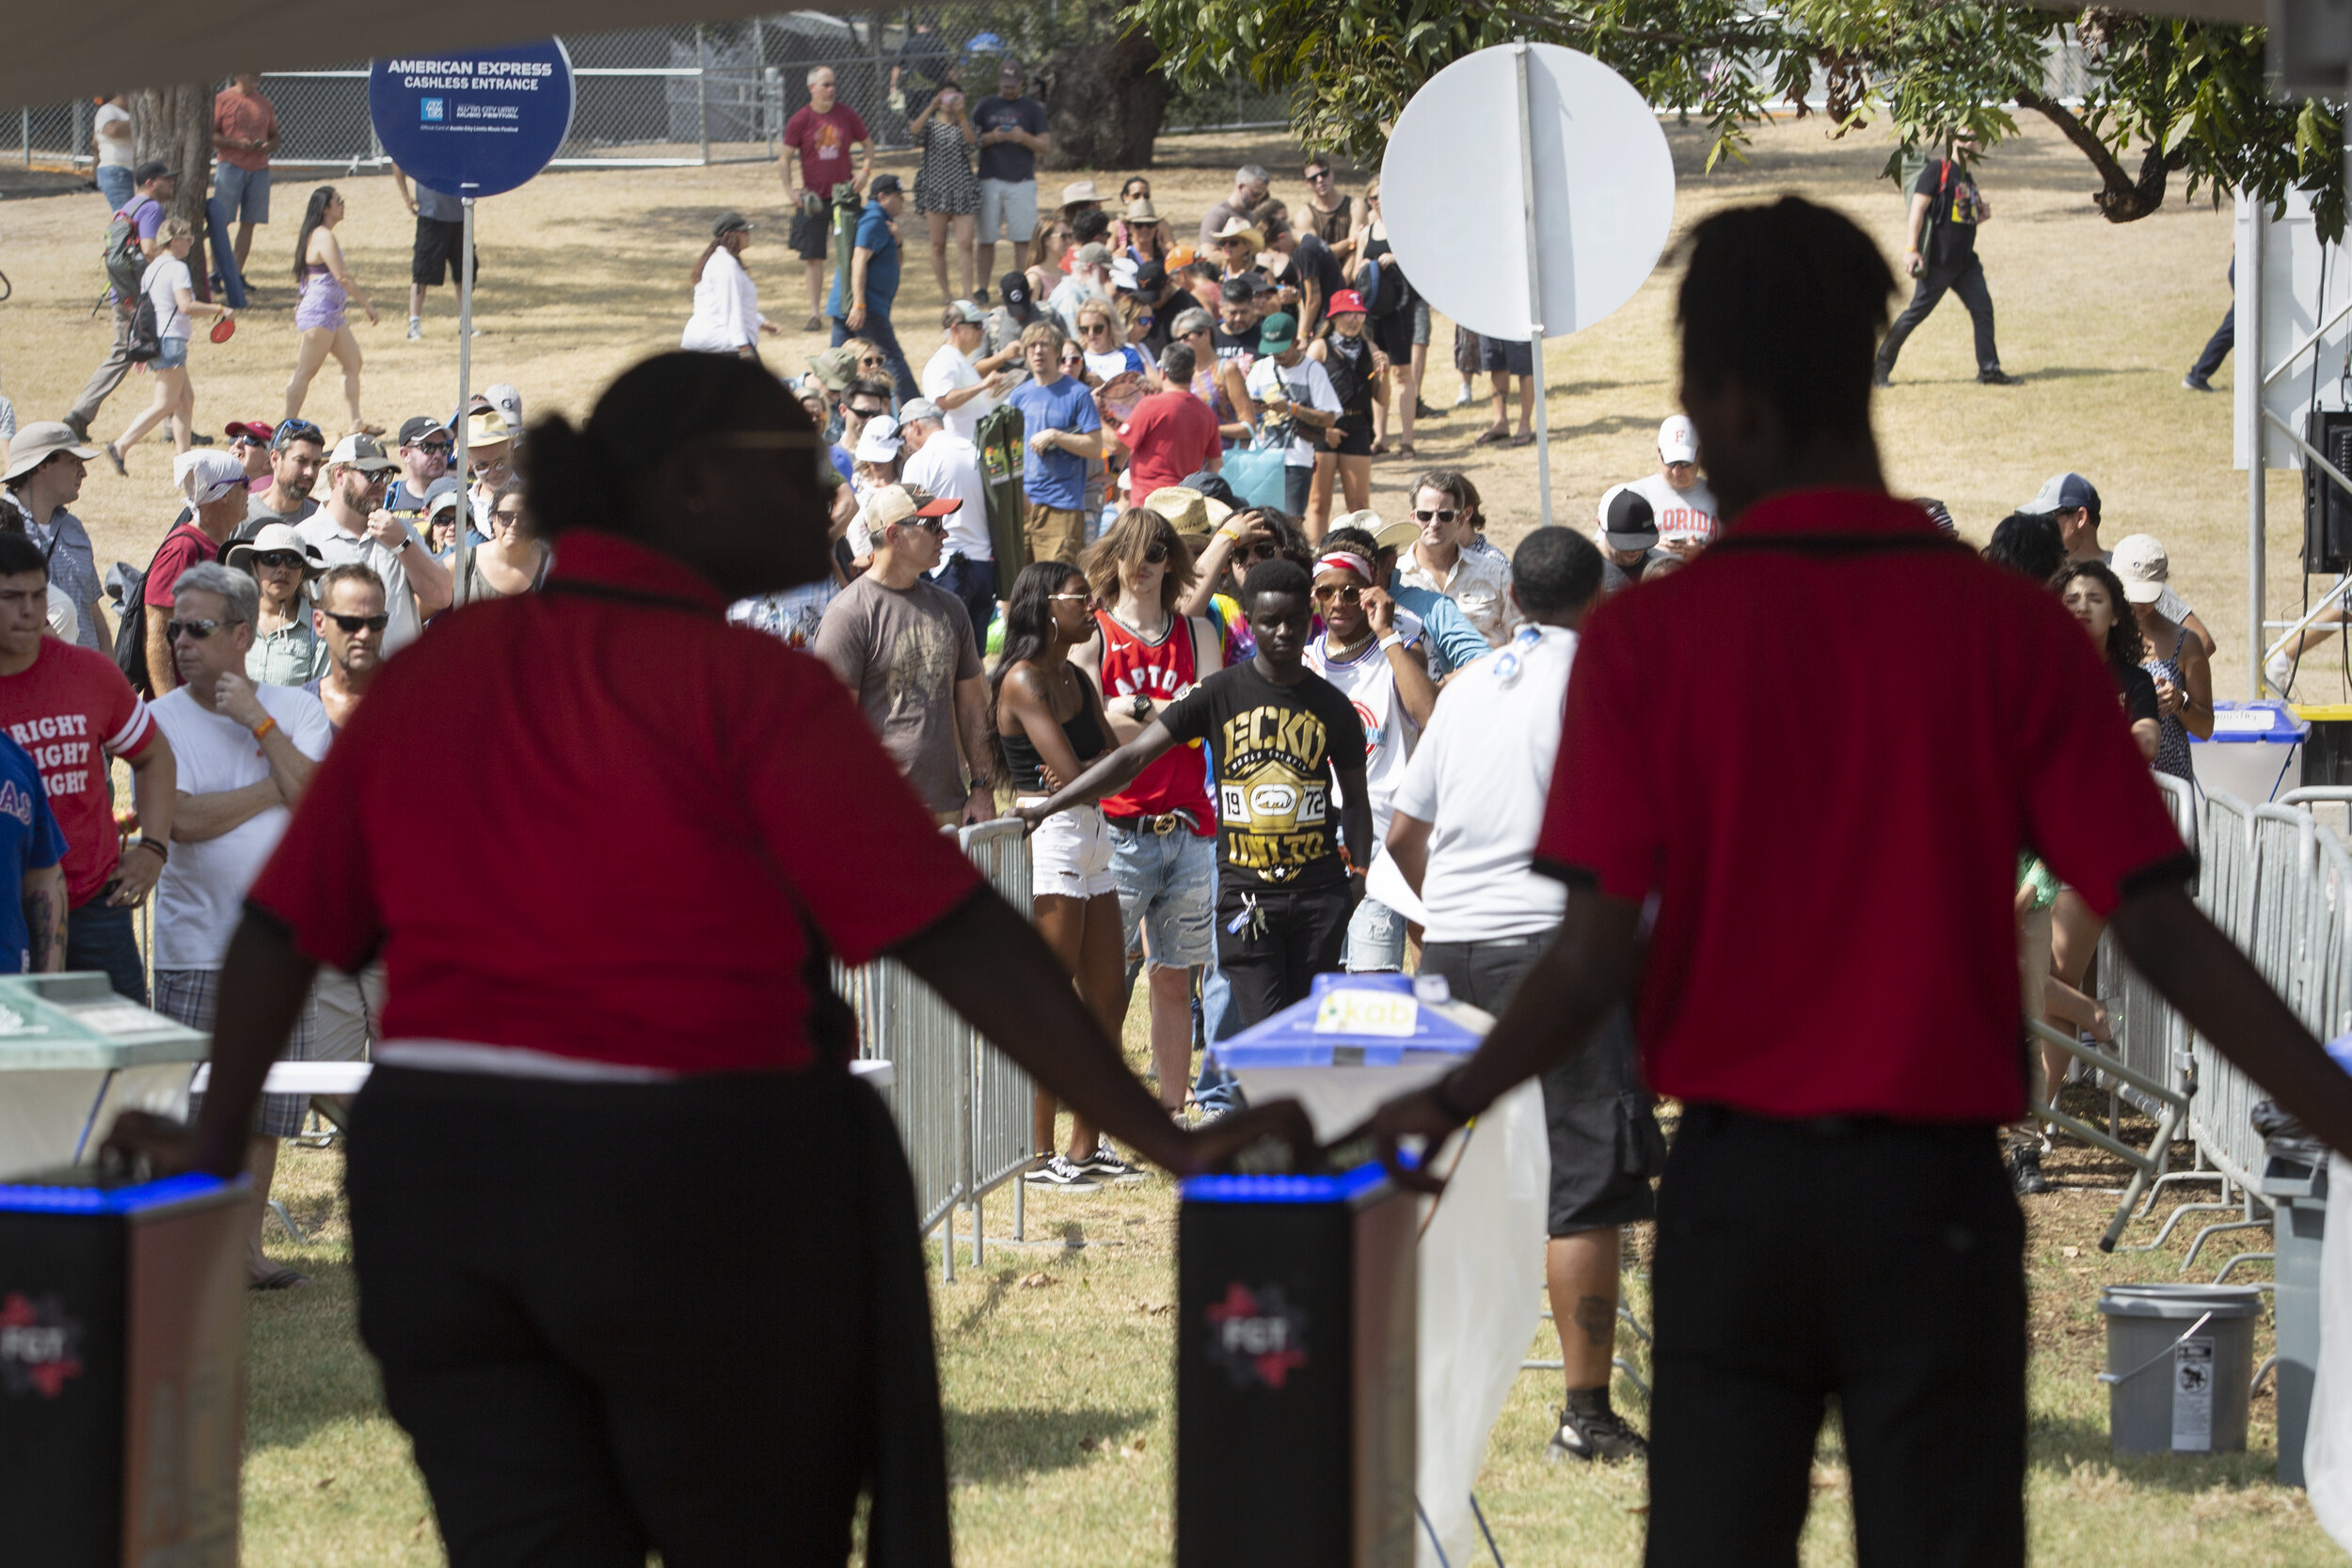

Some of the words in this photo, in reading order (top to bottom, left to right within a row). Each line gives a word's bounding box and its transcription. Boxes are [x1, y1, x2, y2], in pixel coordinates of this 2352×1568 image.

[388, 59, 473, 75] AMERICAN
[477, 61, 553, 77] EXPRESS
[404, 75, 469, 89] CASHLESS
[471, 78, 539, 91] ENTRANCE
[482, 105, 497, 114] CITY
[1653, 509, 1720, 541] ORIDA
[2, 715, 87, 745] RIGHT
[1223, 706, 1327, 771] ECKO
[27, 742, 90, 770] IGHT
[42, 770, 88, 798] IGHT
[1225, 792, 1241, 816] 19
[1304, 791, 1325, 815] 72
[1345, 997, 1410, 1025] kab
